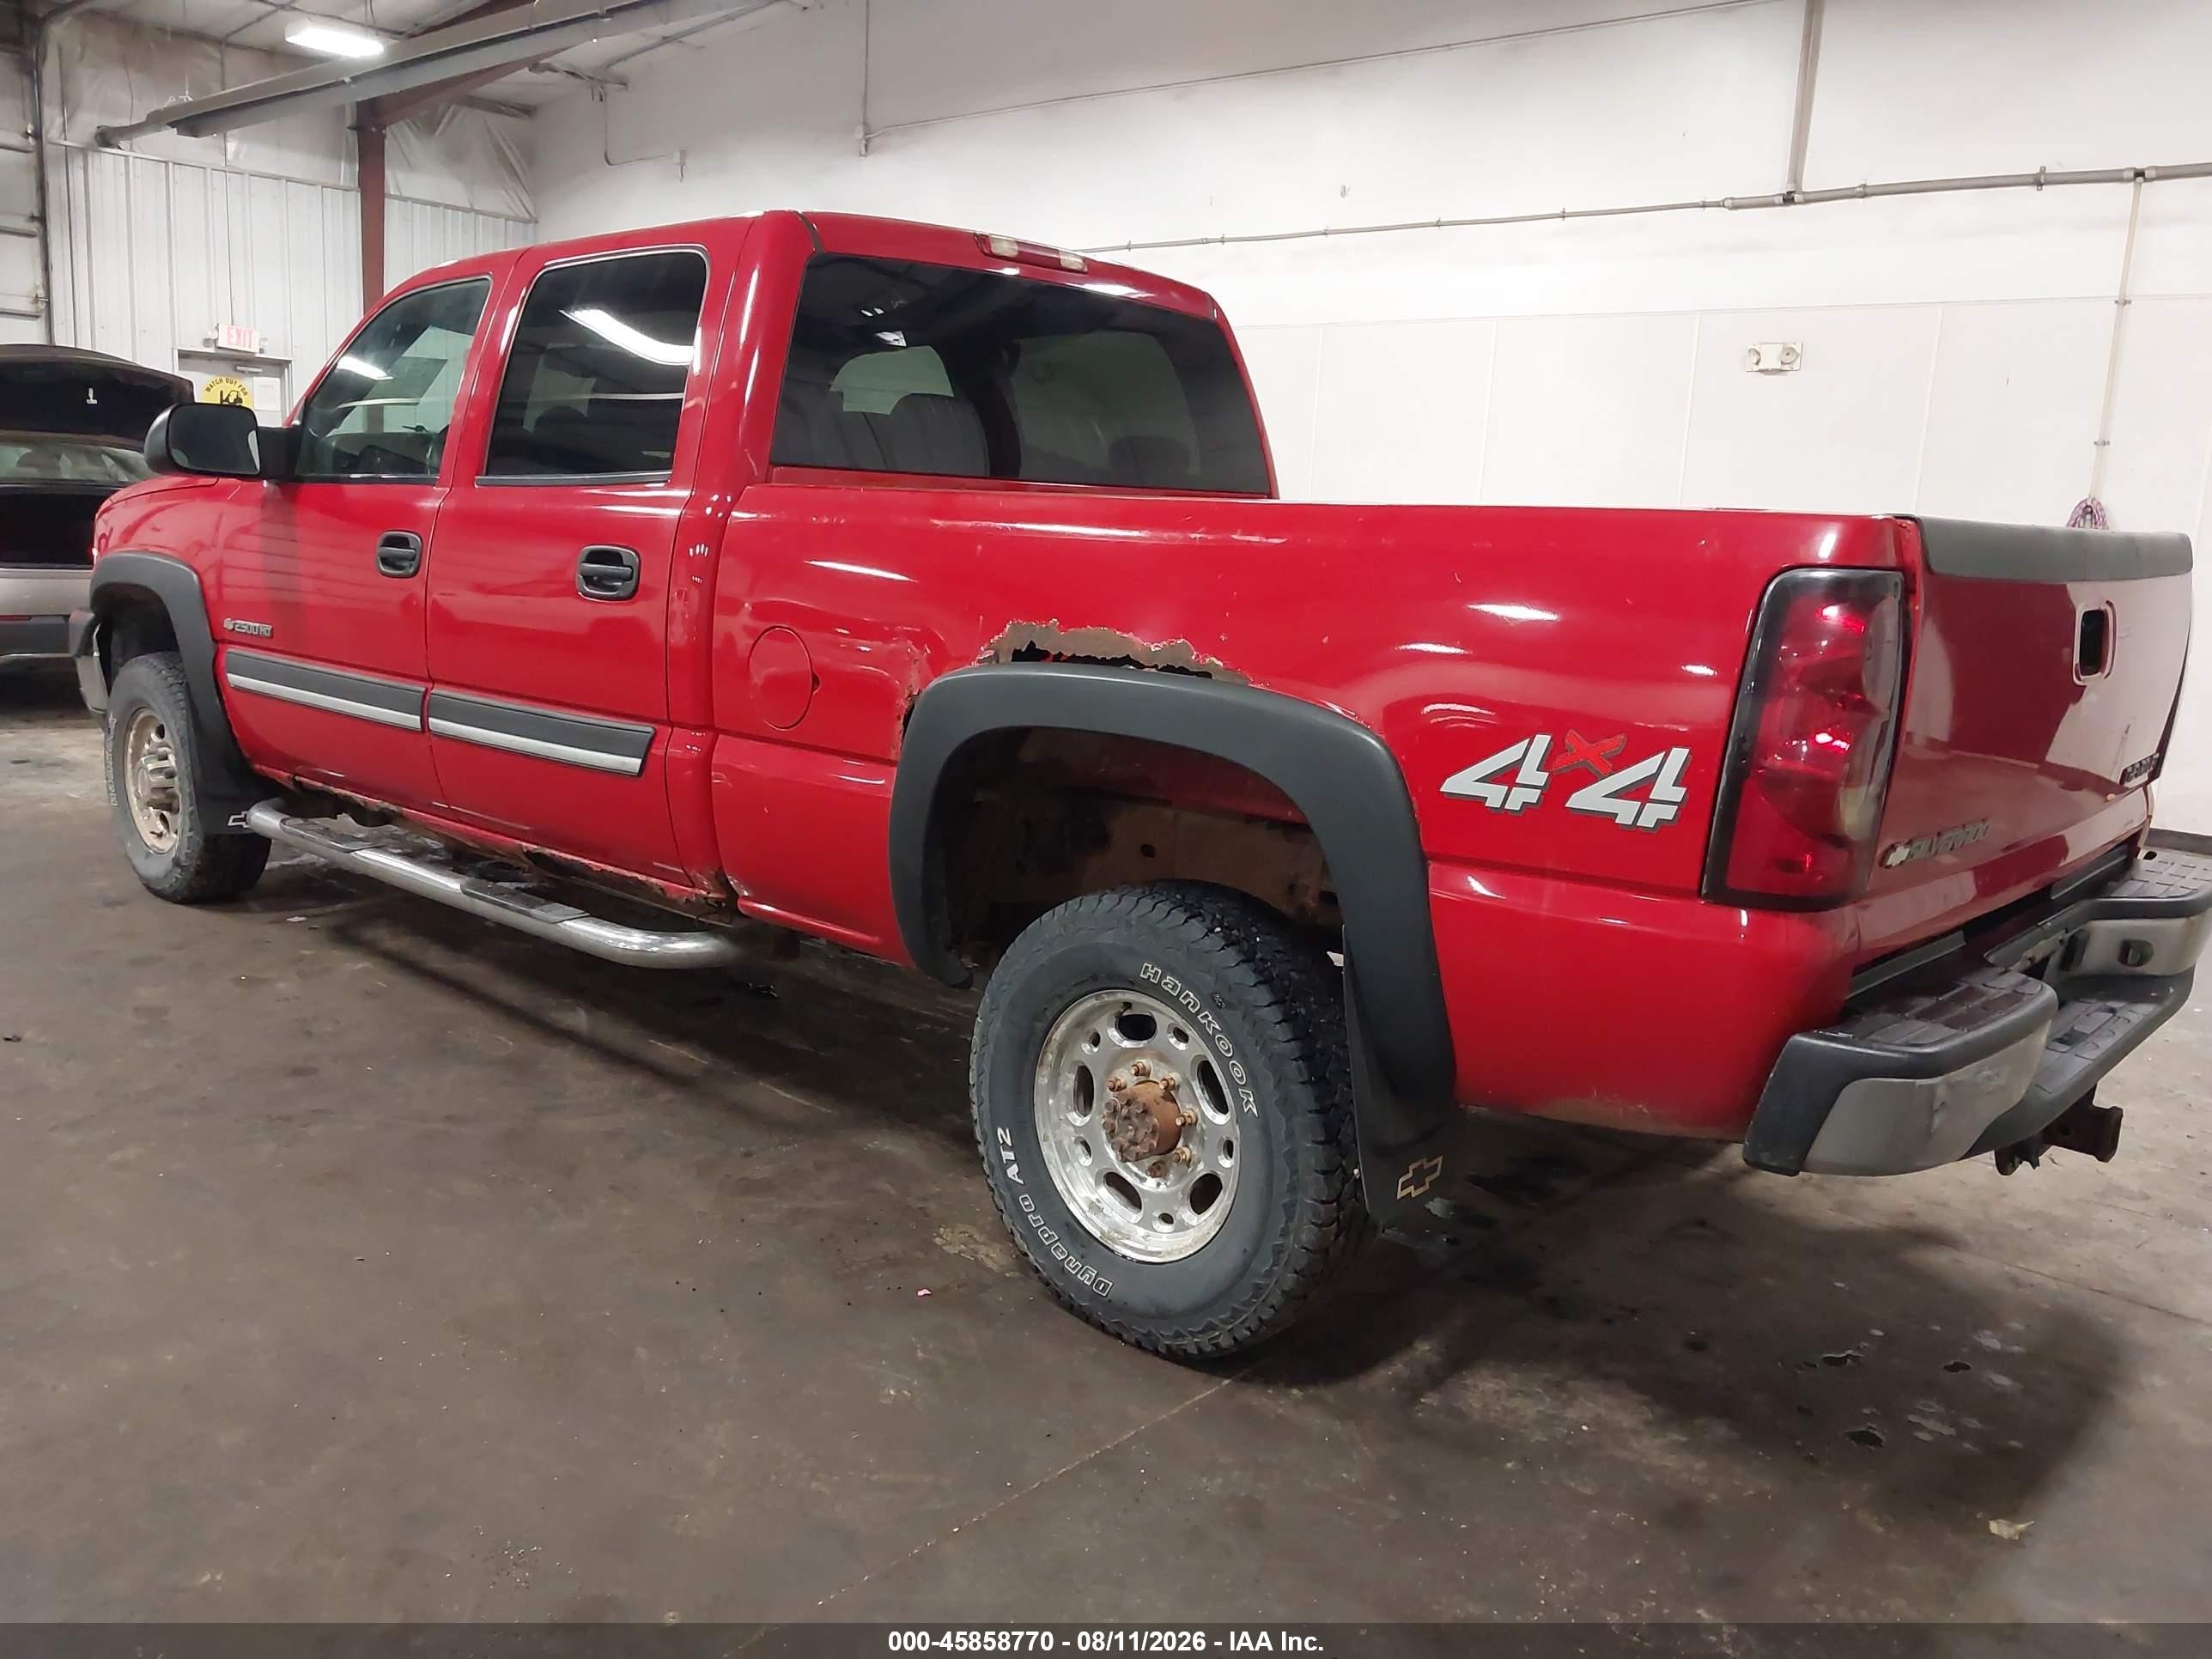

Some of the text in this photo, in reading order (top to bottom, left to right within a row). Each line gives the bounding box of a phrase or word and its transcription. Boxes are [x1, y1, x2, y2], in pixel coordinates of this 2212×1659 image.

[227, 326, 253, 349] EXIT
[205, 377, 248, 397] WATCH OUT FOR
[996, 1126, 1024, 1185] AT2
